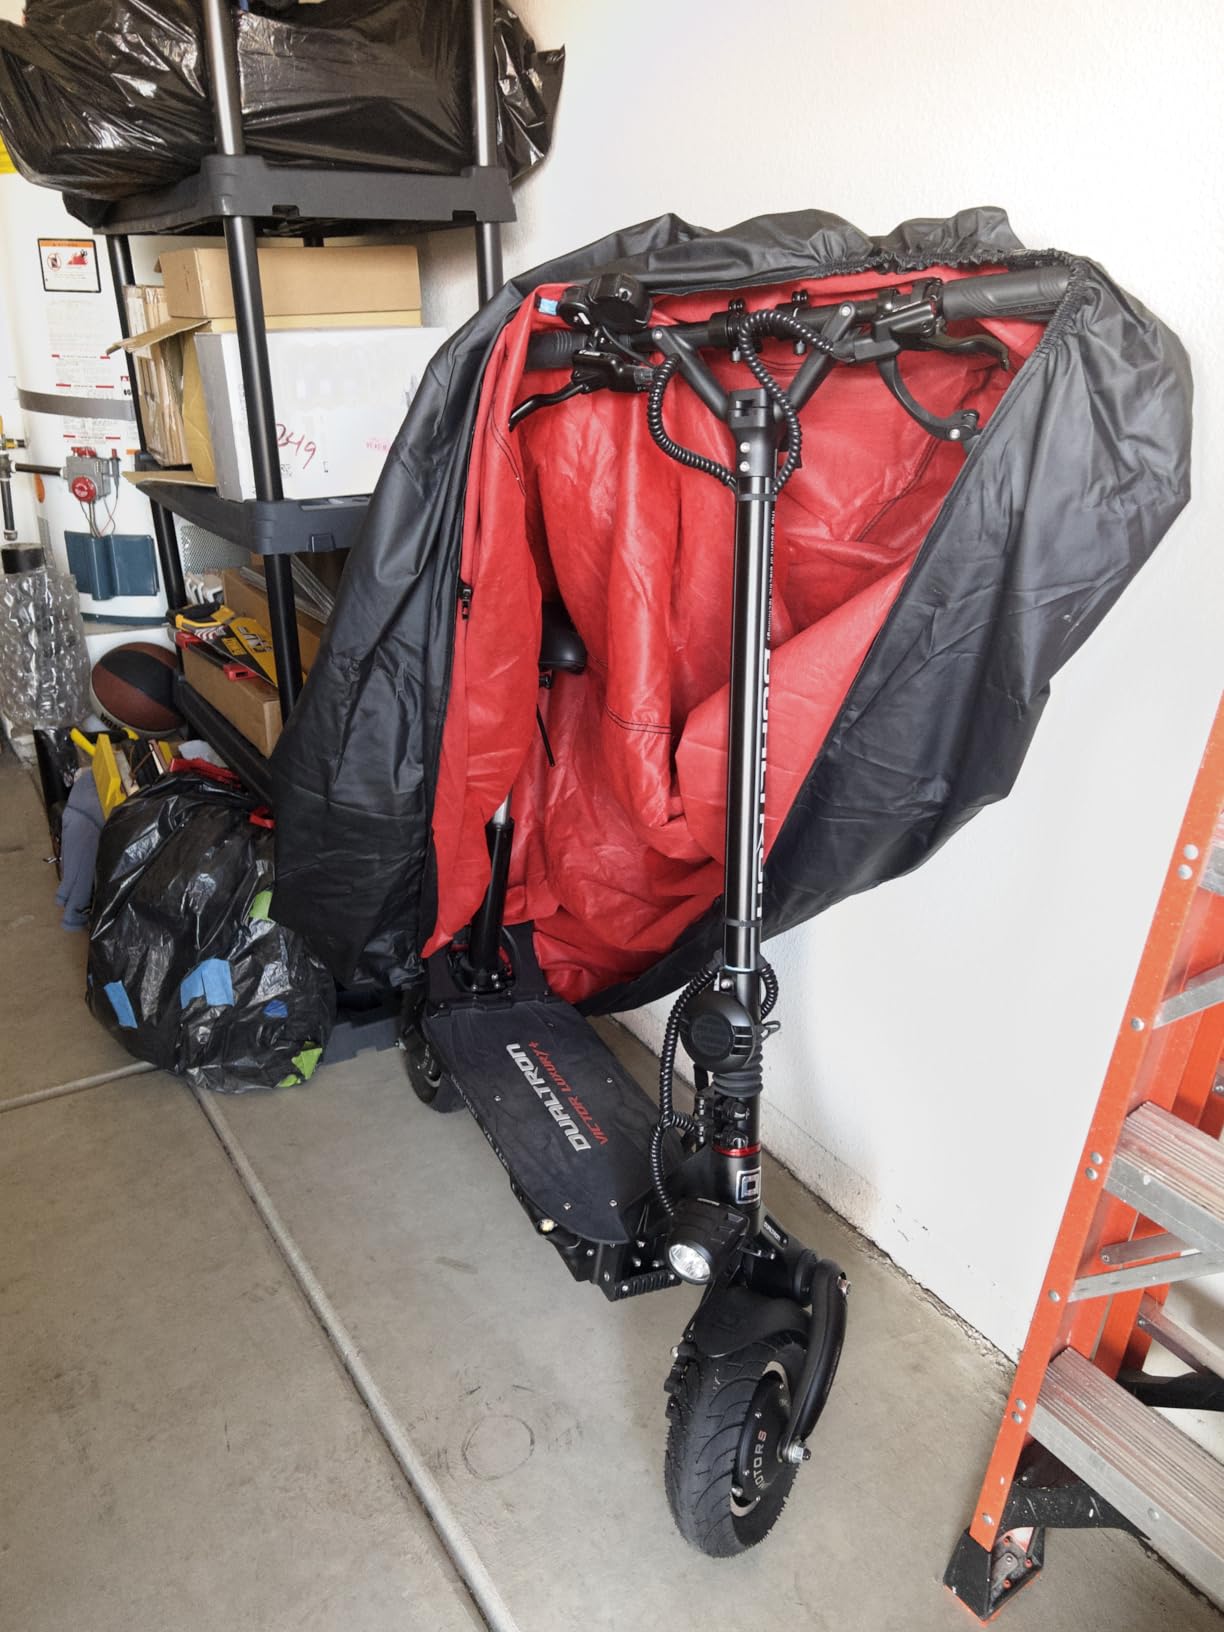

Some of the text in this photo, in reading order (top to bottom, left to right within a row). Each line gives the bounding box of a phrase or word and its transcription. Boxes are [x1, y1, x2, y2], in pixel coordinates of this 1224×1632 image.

[506, 1043, 592, 1152] DUALTRON
[568, 1096, 608, 1145] VICTOR
[753, 1430, 768, 1490] MOTORS
